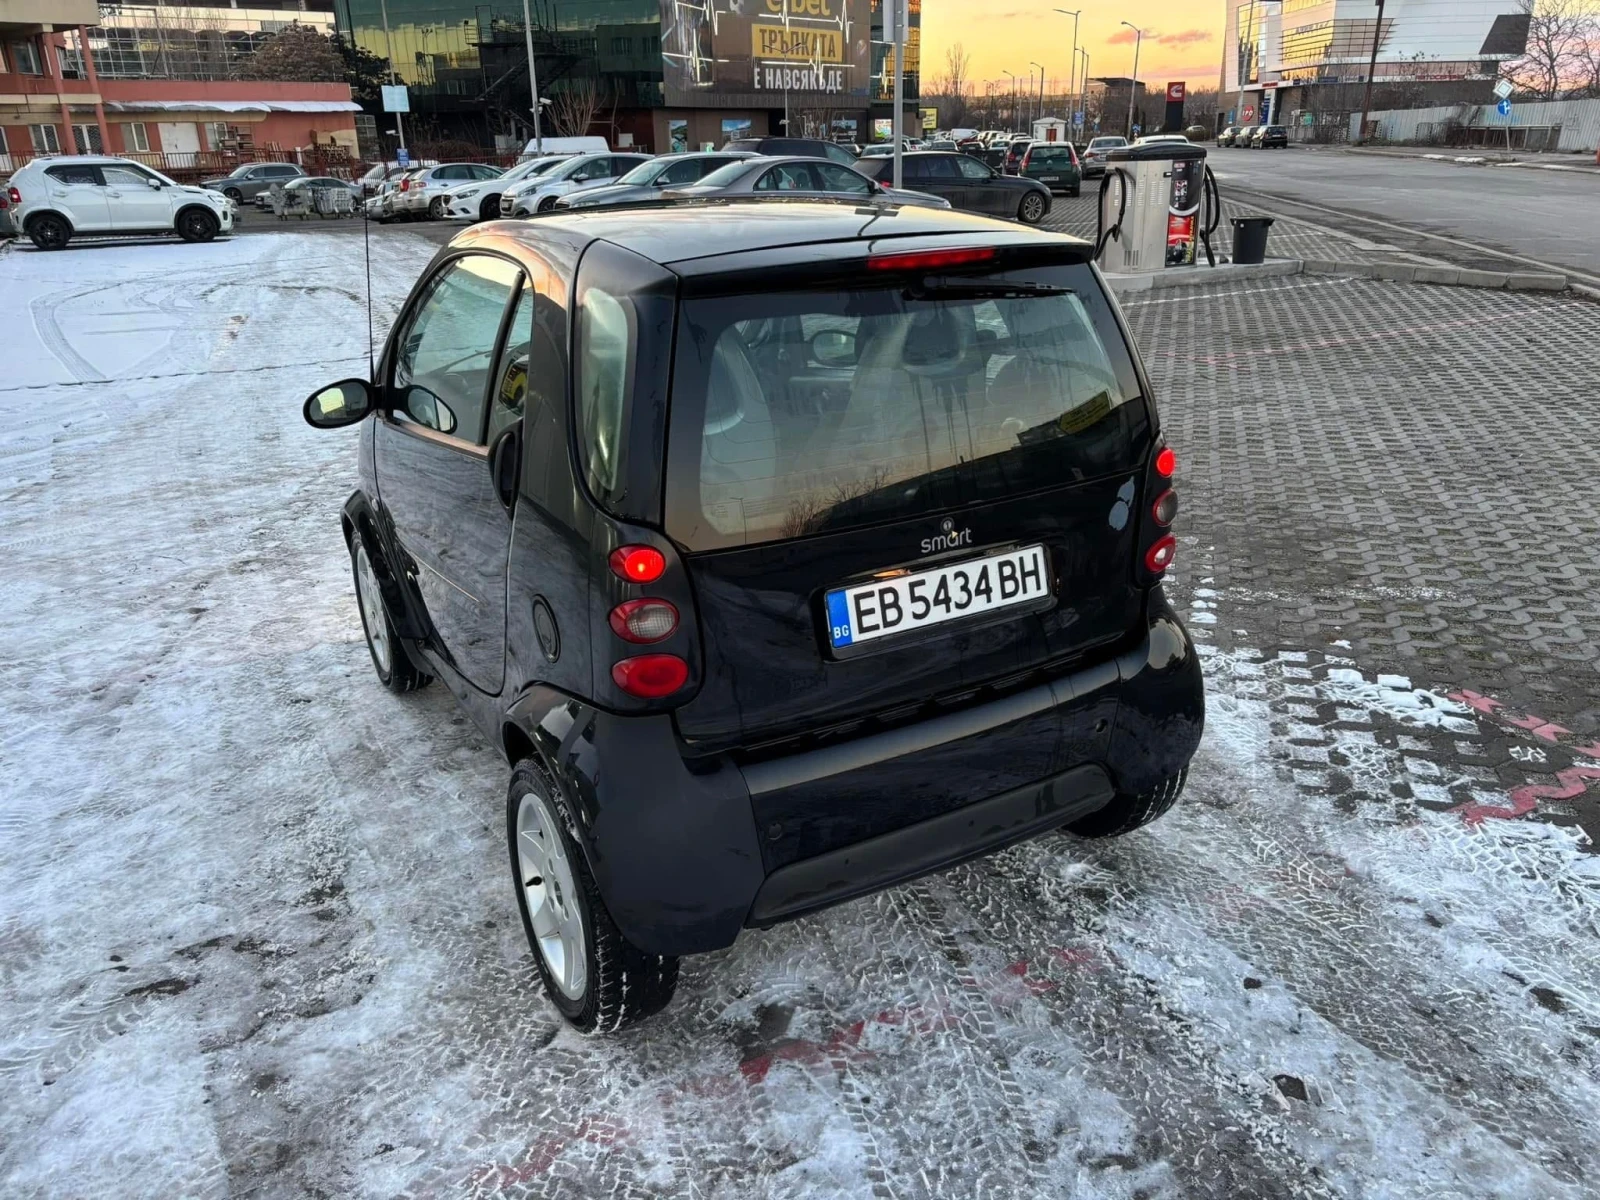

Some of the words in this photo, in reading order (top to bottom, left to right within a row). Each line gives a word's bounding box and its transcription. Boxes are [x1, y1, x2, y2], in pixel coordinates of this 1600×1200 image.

[766, 0, 831, 16] ebet
[759, 28, 836, 58] ТРЪПКАТА
[754, 67, 761, 89] Е
[765, 68, 843, 94] НАВСЯКЪДЕ
[920, 527, 972, 554] smart
[908, 564, 993, 621] 5434
[833, 624, 850, 639] BG
